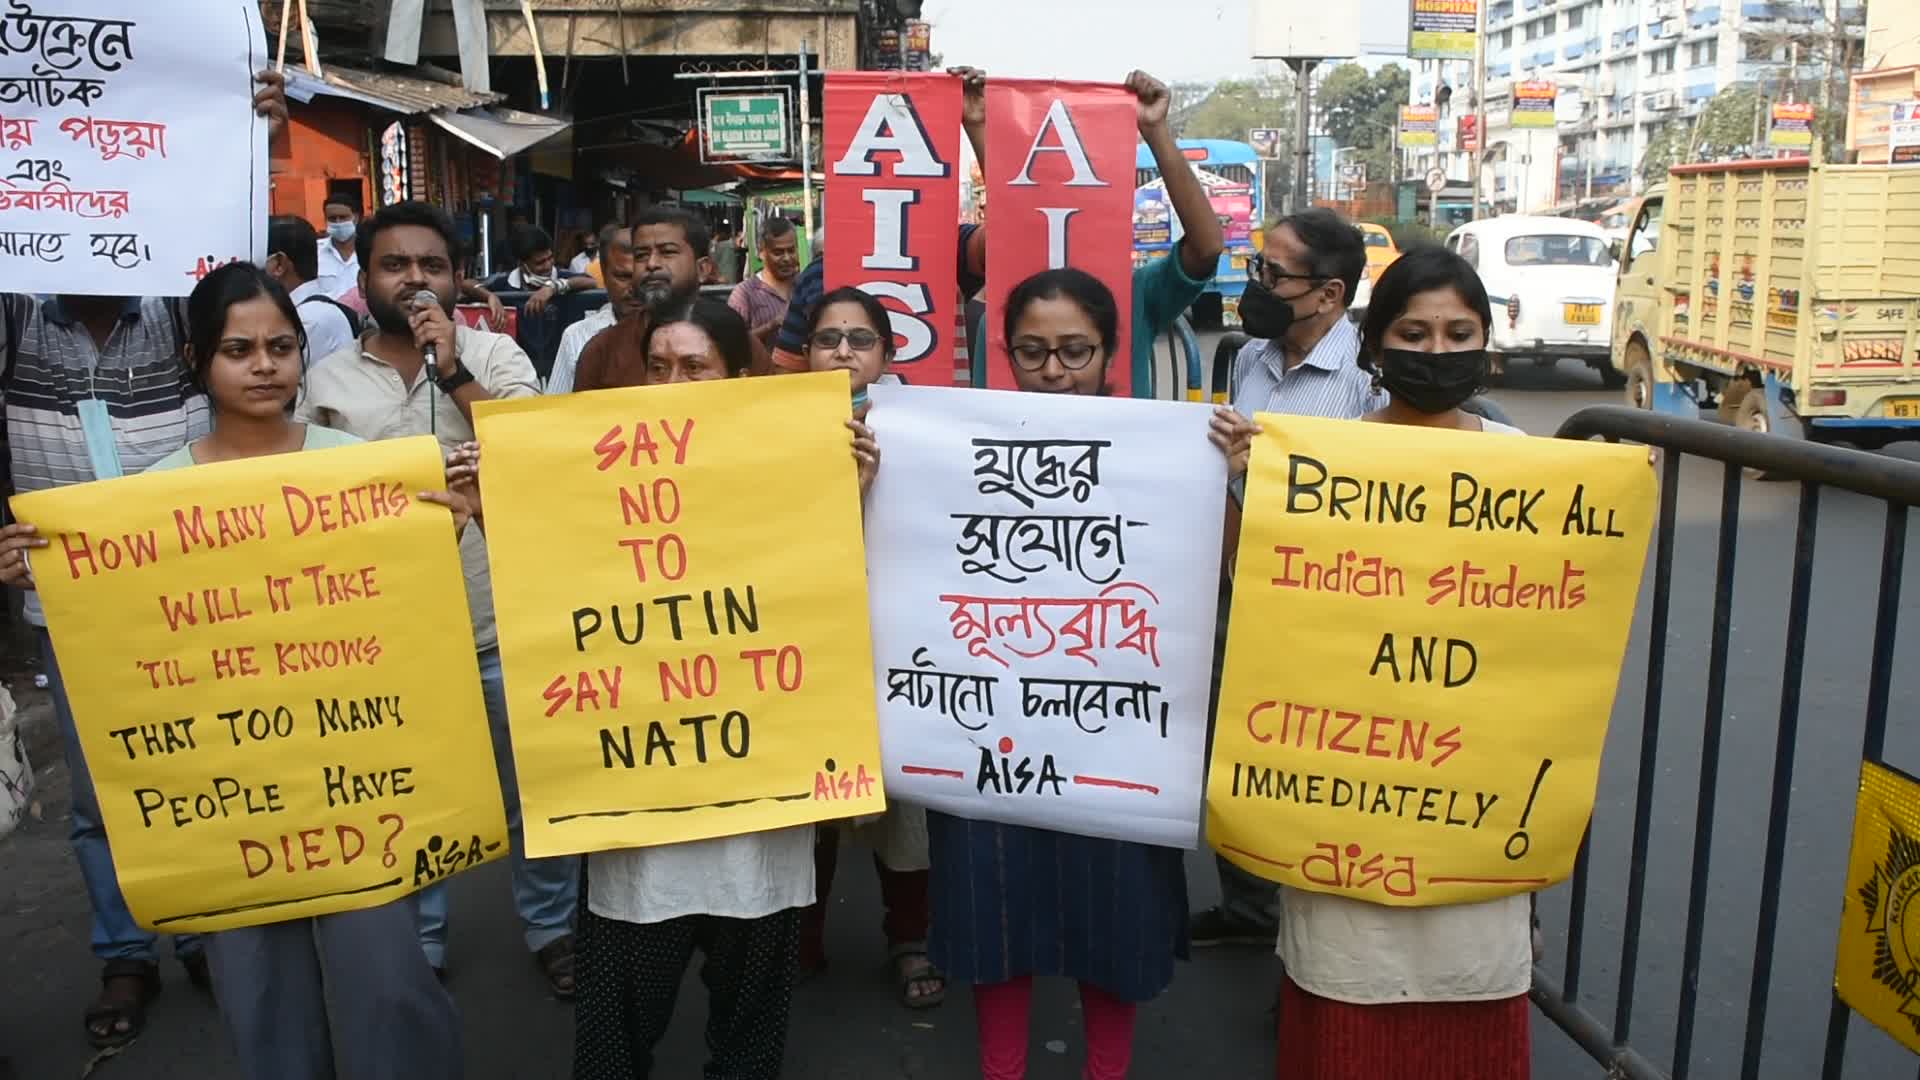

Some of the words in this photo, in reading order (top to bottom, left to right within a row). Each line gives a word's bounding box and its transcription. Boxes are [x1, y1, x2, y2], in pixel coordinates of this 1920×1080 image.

[0, 0, 136, 71] উক্রেনে
[60, 115, 167, 160] পড়ুয়া
[6, 159, 71, 182] এবং
[1876, 308, 1905, 320] SAFE
[593, 418, 695, 471] SAY
[972, 438, 1112, 509] যুদ্ধের
[618, 477, 681, 525] NO
[1285, 453, 1426, 524] BRING
[1448, 472, 1546, 536] BACK
[1561, 484, 1625, 538] ALL
[60, 529, 158, 579] HOW
[174, 504, 266, 555] MANY
[282, 481, 410, 537] DEATHS
[618, 533, 687, 583] TO
[159, 587, 252, 632] WILL
[265, 575, 293, 613] IT
[302, 565, 381, 607] TAKE
[1271, 545, 1405, 599] Indian
[572, 584, 759, 652] PUTIN
[212, 645, 260, 679] HE
[274, 636, 383, 675] KNOWS
[542, 665, 623, 718] SAY
[658, 653, 719, 702] NO
[739, 644, 803, 692] TO
[1369, 632, 1479, 688] AND
[110, 717, 196, 760] THAT
[218, 705, 294, 747] TOO
[316, 695, 404, 738] MANY
[600, 710, 750, 769] NATO
[1246, 700, 1462, 768] CITIZENS
[134, 776, 285, 828] PEOPLE
[323, 766, 415, 807] HAVE
[239, 814, 405, 879] DIED?
